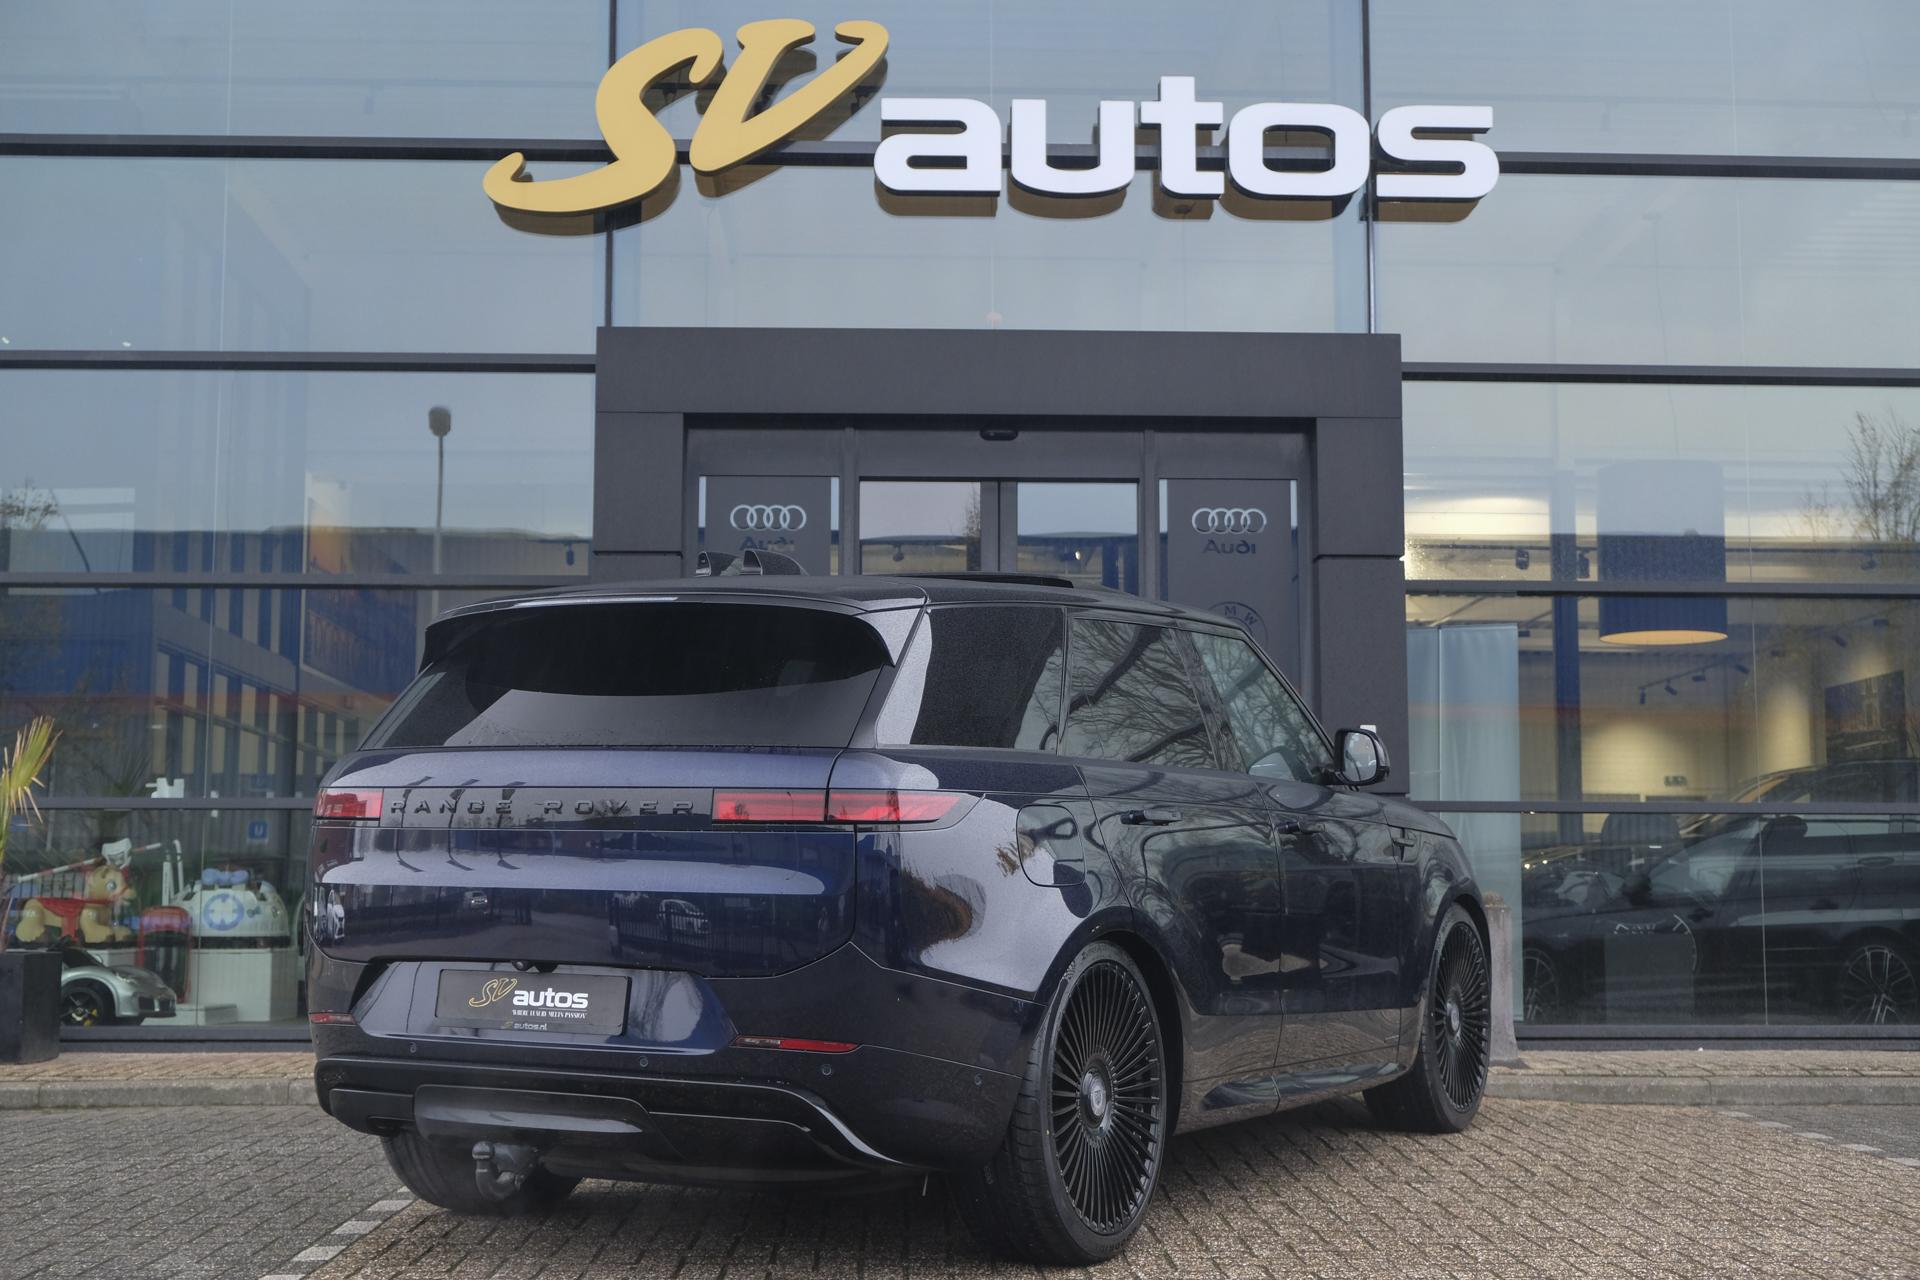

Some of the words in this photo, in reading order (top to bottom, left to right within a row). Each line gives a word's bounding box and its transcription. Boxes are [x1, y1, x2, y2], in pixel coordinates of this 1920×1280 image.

[874, 75, 1500, 199] autos
[1203, 539, 1257, 554] Audi
[390, 799, 513, 815] RANGE
[543, 799, 694, 816] ROVER
[512, 988, 589, 1009] autos
